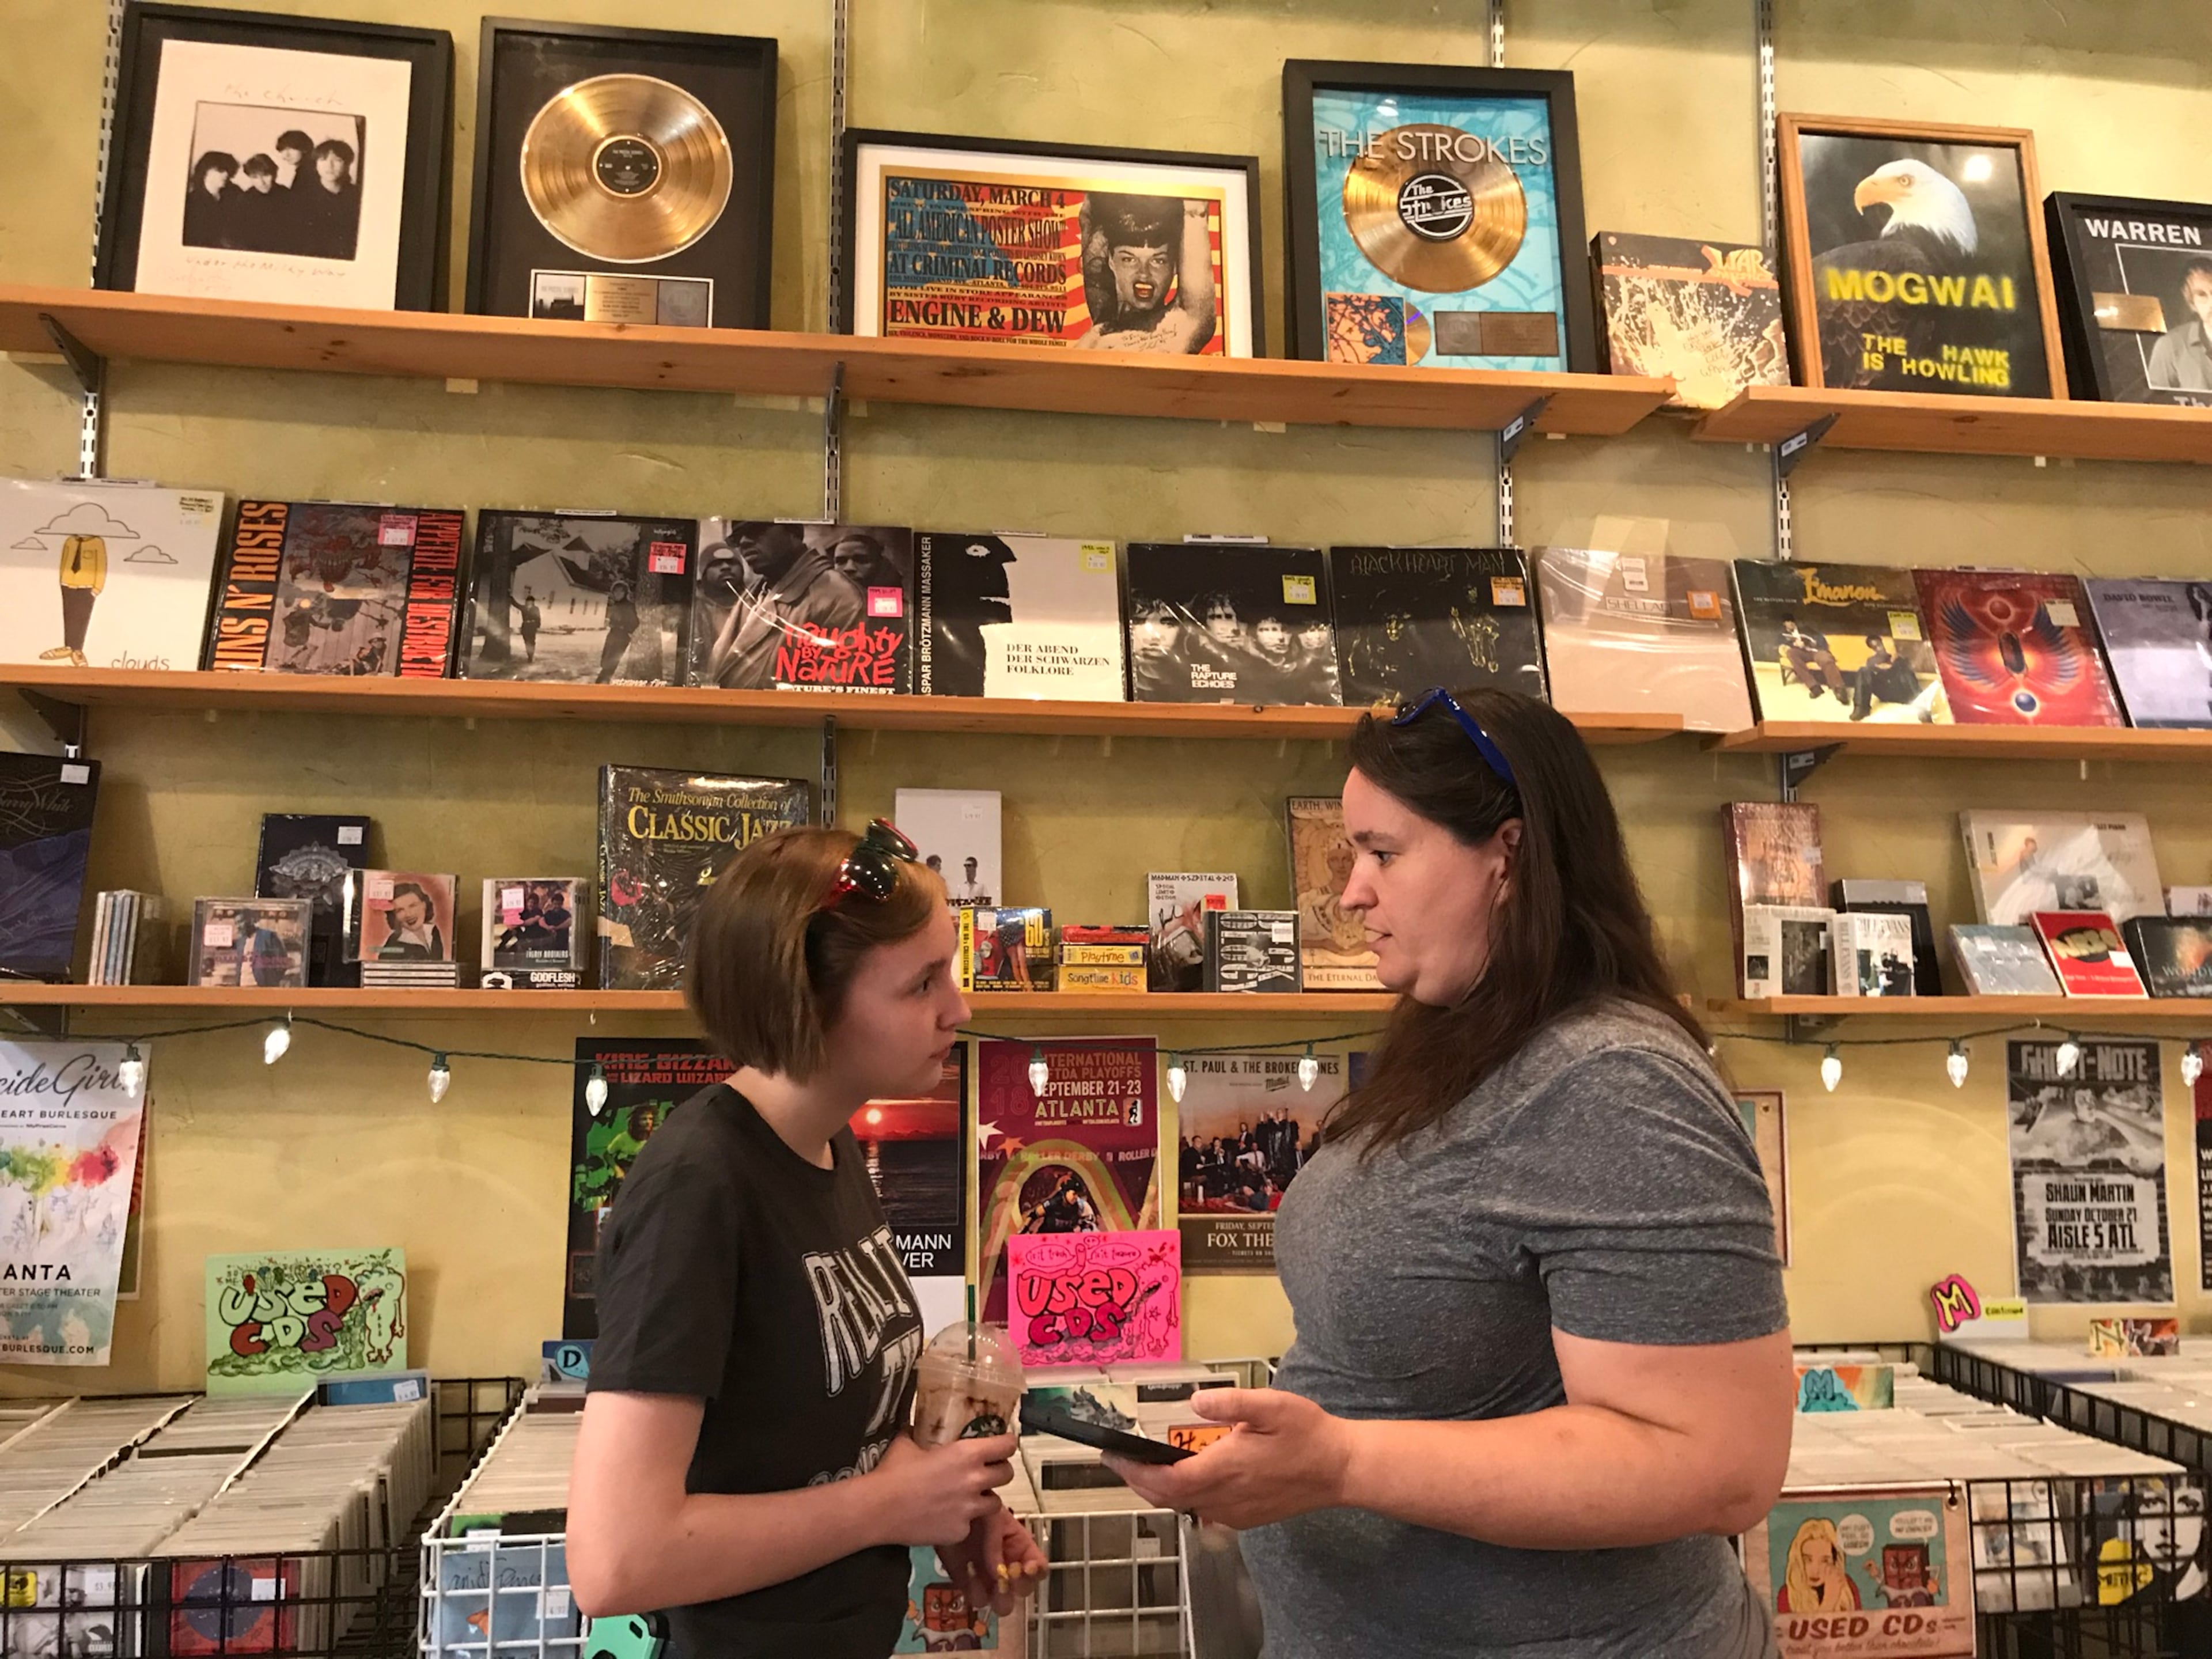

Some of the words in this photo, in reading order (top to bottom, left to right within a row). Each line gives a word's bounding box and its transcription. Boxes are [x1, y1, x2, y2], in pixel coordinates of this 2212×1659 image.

[1319, 130, 1384, 159] THE
[1396, 131, 1547, 166] STROKES
[891, 179, 984, 206] SATURDAY,
[989, 185, 1051, 208] MARCH
[1056, 191, 1065, 209] 4
[1411, 184, 1434, 195] The
[918, 211, 979, 244] AMERICAN
[979, 215, 1025, 247] POSTER
[2084, 217, 2202, 247] WARREN
[889, 254, 907, 274] AT
[912, 255, 991, 279] CRIMINAL
[994, 260, 1067, 285] RECORDS
[1825, 267, 2016, 310] MOGWAI
[889, 299, 982, 328] ENGINE
[987, 306, 1005, 330] &
[1011, 307, 1067, 334] DEW
[1862, 332, 1907, 356] THE
[1942, 344, 2009, 368] HAWK
[1862, 351, 1885, 371] IS
[1902, 357, 2010, 388] HOWLING
[230, 502, 289, 582] ROSES
[921, 536, 933, 594] MASSAKER
[1797, 567, 1887, 607] Emanon
[2103, 593, 2137, 602] DAVID
[919, 596, 933, 664] BRÖTZMANN
[213, 616, 270, 672] UNS
[1006, 643, 1032, 653] DER
[1036, 645, 1080, 655] ABEND
[111, 650, 171, 672] clouds
[801, 646, 822, 660] BY
[1006, 654, 1033, 664] DER
[1036, 656, 1110, 666] SCHWARZEN
[1006, 665, 1075, 676] FOLKLORE
[1191, 664, 1211, 672] THE
[921, 665, 933, 696] SPAR
[1191, 672, 1237, 681] RAPTURE
[1191, 680, 1235, 688] ECHOES
[846, 686, 896, 695] FINEST
[628, 786, 651, 803] The
[652, 789, 724, 809] Smithsonian
[726, 793, 778, 811] Collection
[780, 797, 793, 815] of
[1291, 800, 1323, 812] EARTH,
[627, 804, 730, 843] CLASSIC
[733, 812, 794, 851] JAZ
[1081, 950, 1125, 963] Playtime
[530, 972, 575, 983] GODFLESH
[1307, 974, 1323, 982] THE
[1327, 974, 1363, 982] ETERNAL
[1044, 1052, 1142, 1067] TERNATIONAL
[1183, 1060, 1198, 1073] ST.
[1202, 1061, 1226, 1074] PAUL
[1230, 1061, 1239, 1074] &
[1243, 1062, 1262, 1074] THE
[620, 1072, 673, 1084] LIZARD
[1081, 1066, 1142, 1080] PLAYOFFS
[1107, 1080, 1143, 1096] 21-23
[40, 1110, 118, 1119] BURLESQUE
[1035, 1099, 1120, 1118] ATLANTA
[1118, 1149, 1150, 1161] ROLLER
[2045, 1183, 2086, 1203] SHAUN
[2089, 1183, 2135, 1203] MARTIN
[2045, 1207, 2082, 1223] SUNDAY
[2084, 1207, 2124, 1223] OCTOBER
[1215, 1222, 1246, 1231] FRIDAY,
[895, 1234, 952, 1250] MANN
[1207, 1233, 1238, 1248] FOX
[2048, 1224, 2089, 1249] AISLE
[2094, 1224, 2104, 1249] 5
[2108, 1224, 2137, 1249] ATL
[3, 1263, 72, 1281] ANTA
[18, 1288, 51, 1297] STAGE
[52, 1288, 101, 1297] THEATER
[1934, 1280, 1976, 1330] M
[1028, 1302, 1126, 1346] CDS
[2, 1344, 95, 1354] BURLESQUE.COM
[1804, 1368, 1835, 1400] M
[1787, 1615, 1870, 1642] USED
[1882, 1613, 1938, 1637] CDs
